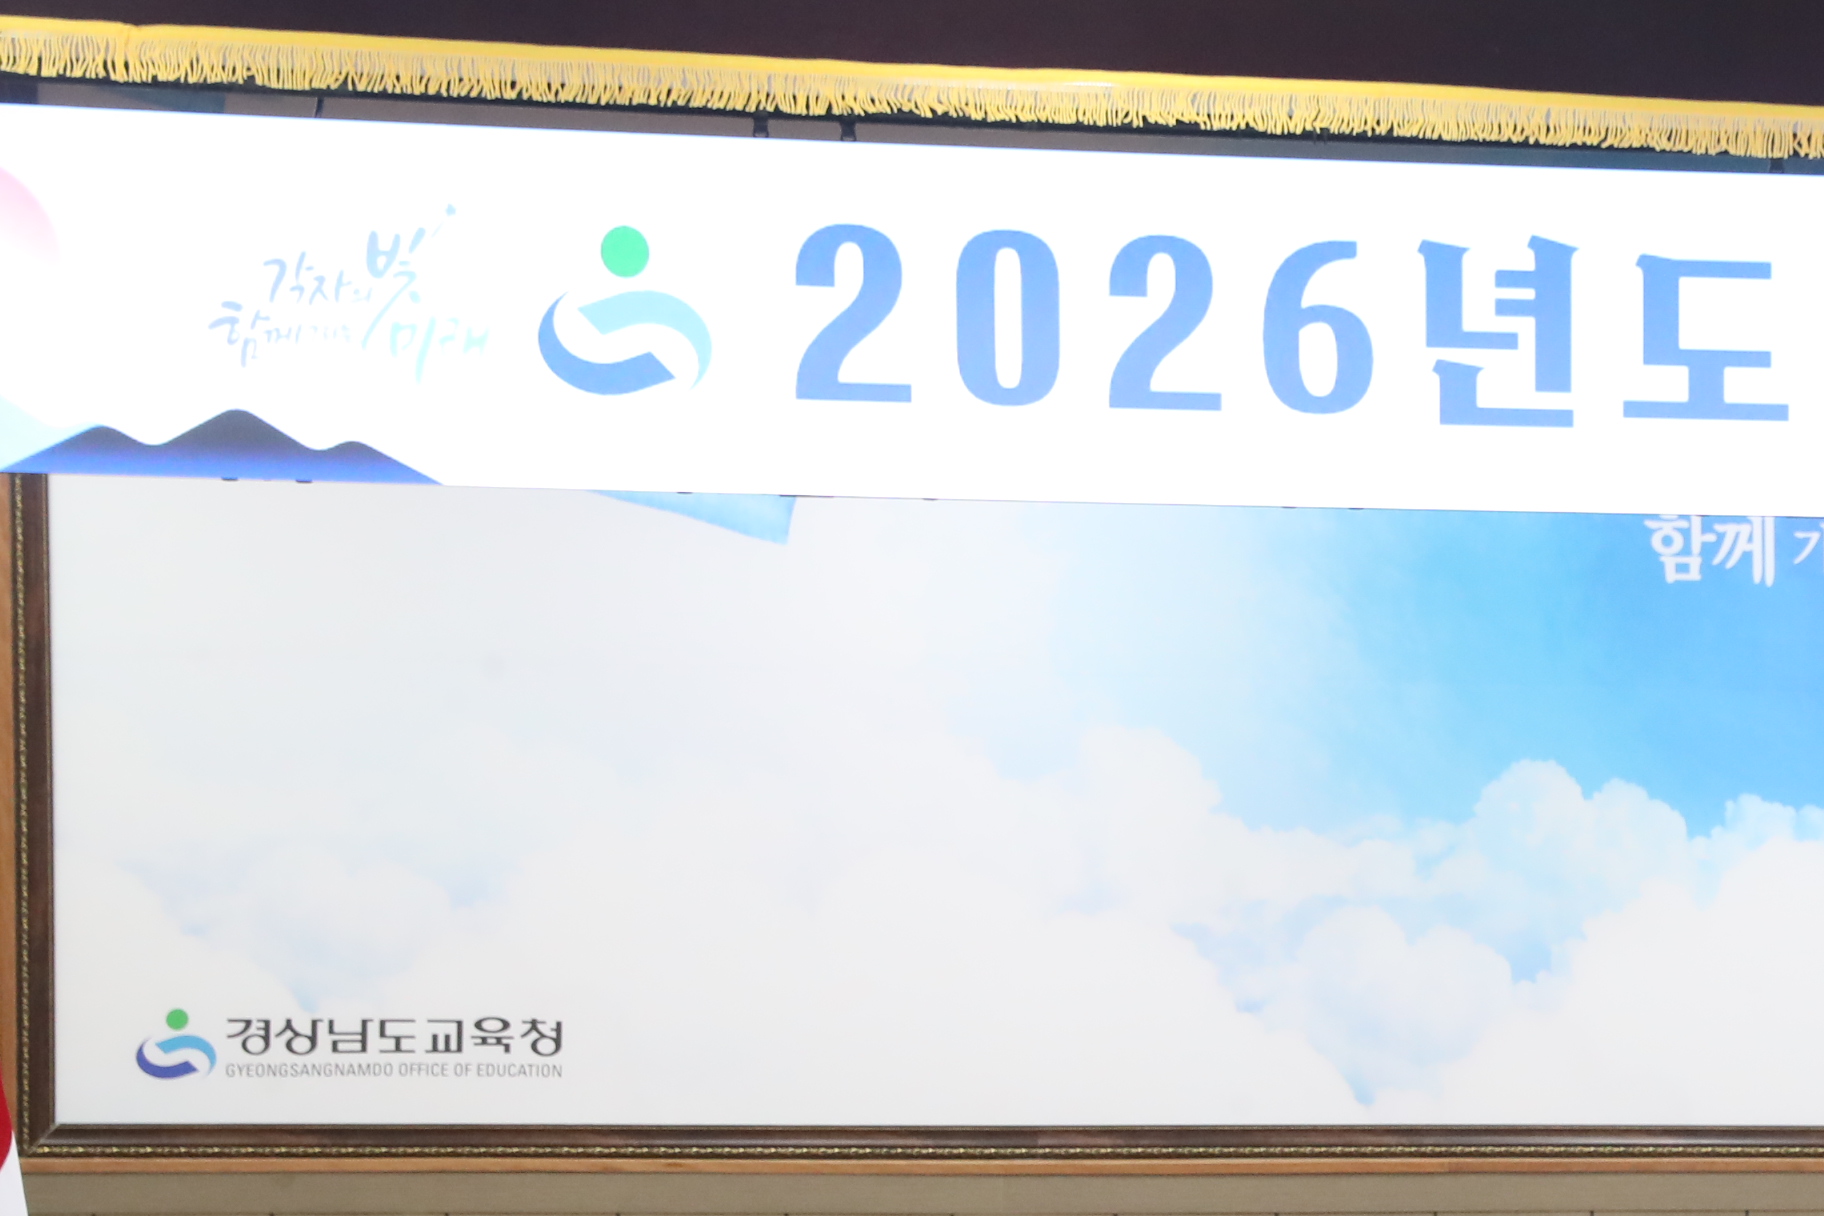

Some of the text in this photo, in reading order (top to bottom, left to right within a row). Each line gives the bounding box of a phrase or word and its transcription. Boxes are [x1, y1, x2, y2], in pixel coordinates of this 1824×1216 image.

[794, 222, 1790, 429] 2026년도
[1644, 514, 1775, 587] 함께
[226, 1016, 564, 1057] 경상남도교육청
[225, 1062, 564, 1079] GYEONGSANGNAMDO OFFICE OF EDUCATION
